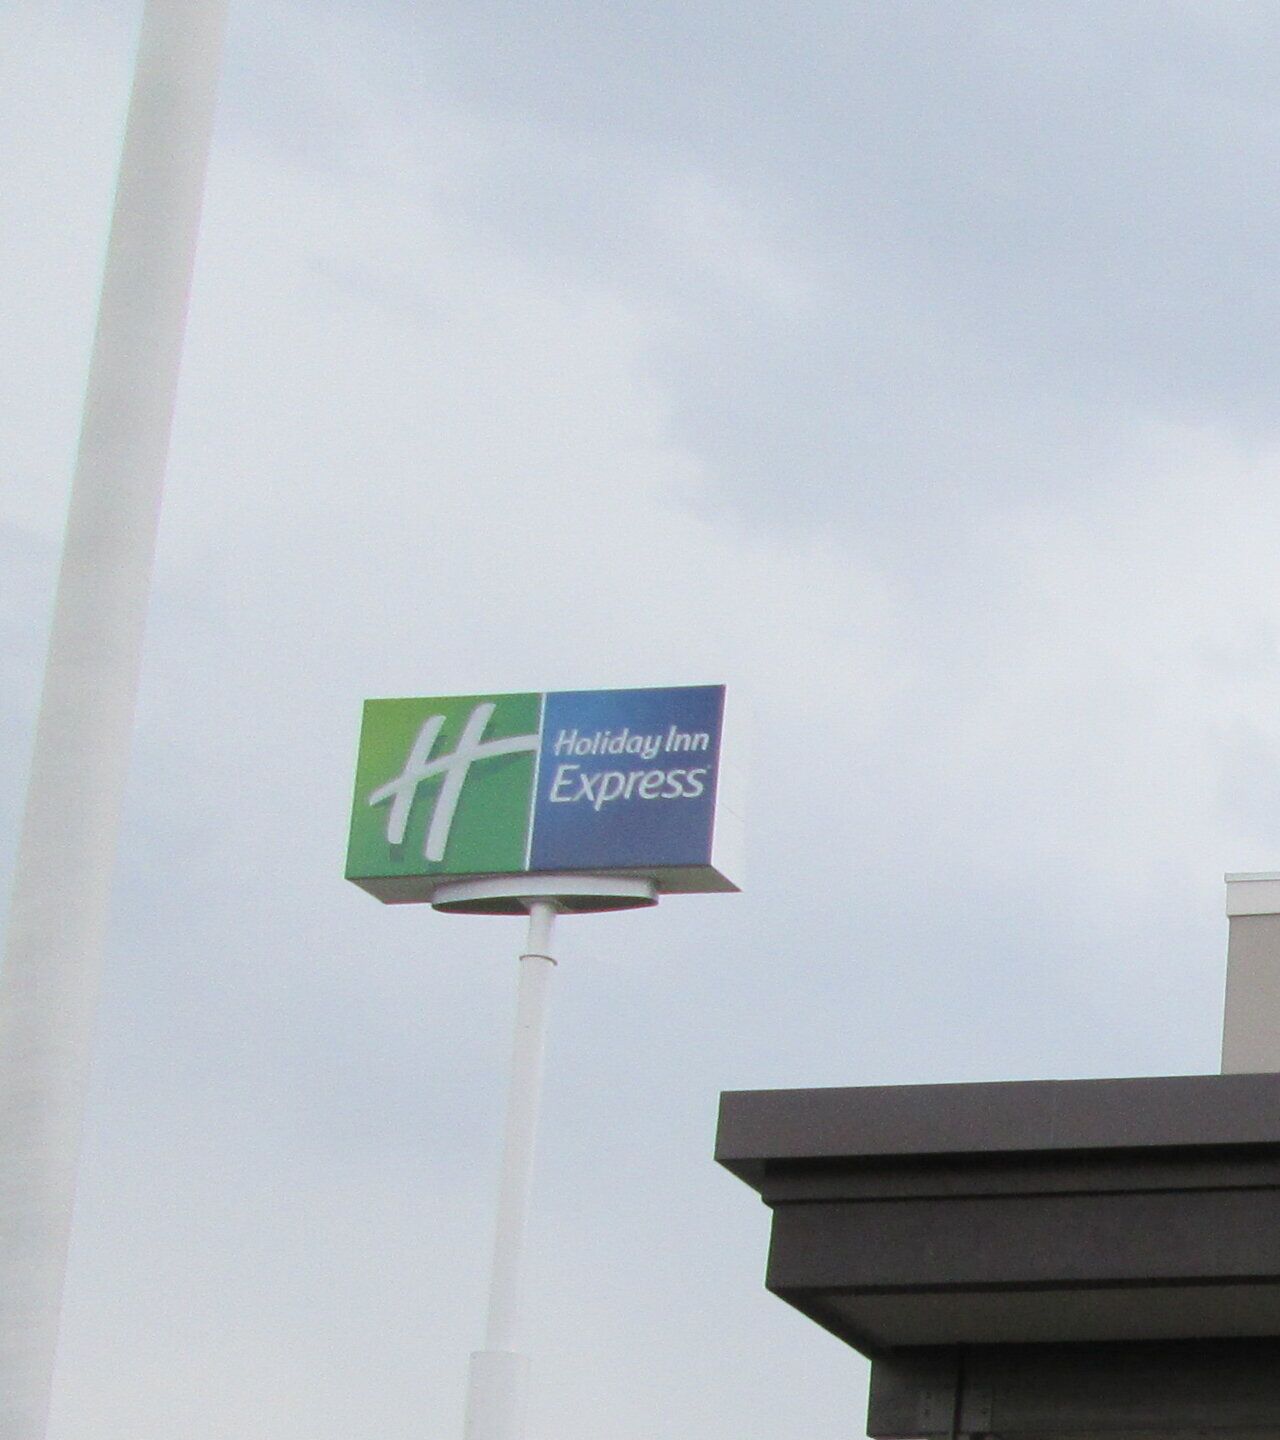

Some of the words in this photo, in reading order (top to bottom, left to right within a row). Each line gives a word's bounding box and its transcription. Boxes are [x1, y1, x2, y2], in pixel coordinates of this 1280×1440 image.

[554, 727, 666, 760] Holiday
[667, 725, 710, 752] Inn
[550, 764, 706, 811] Express
